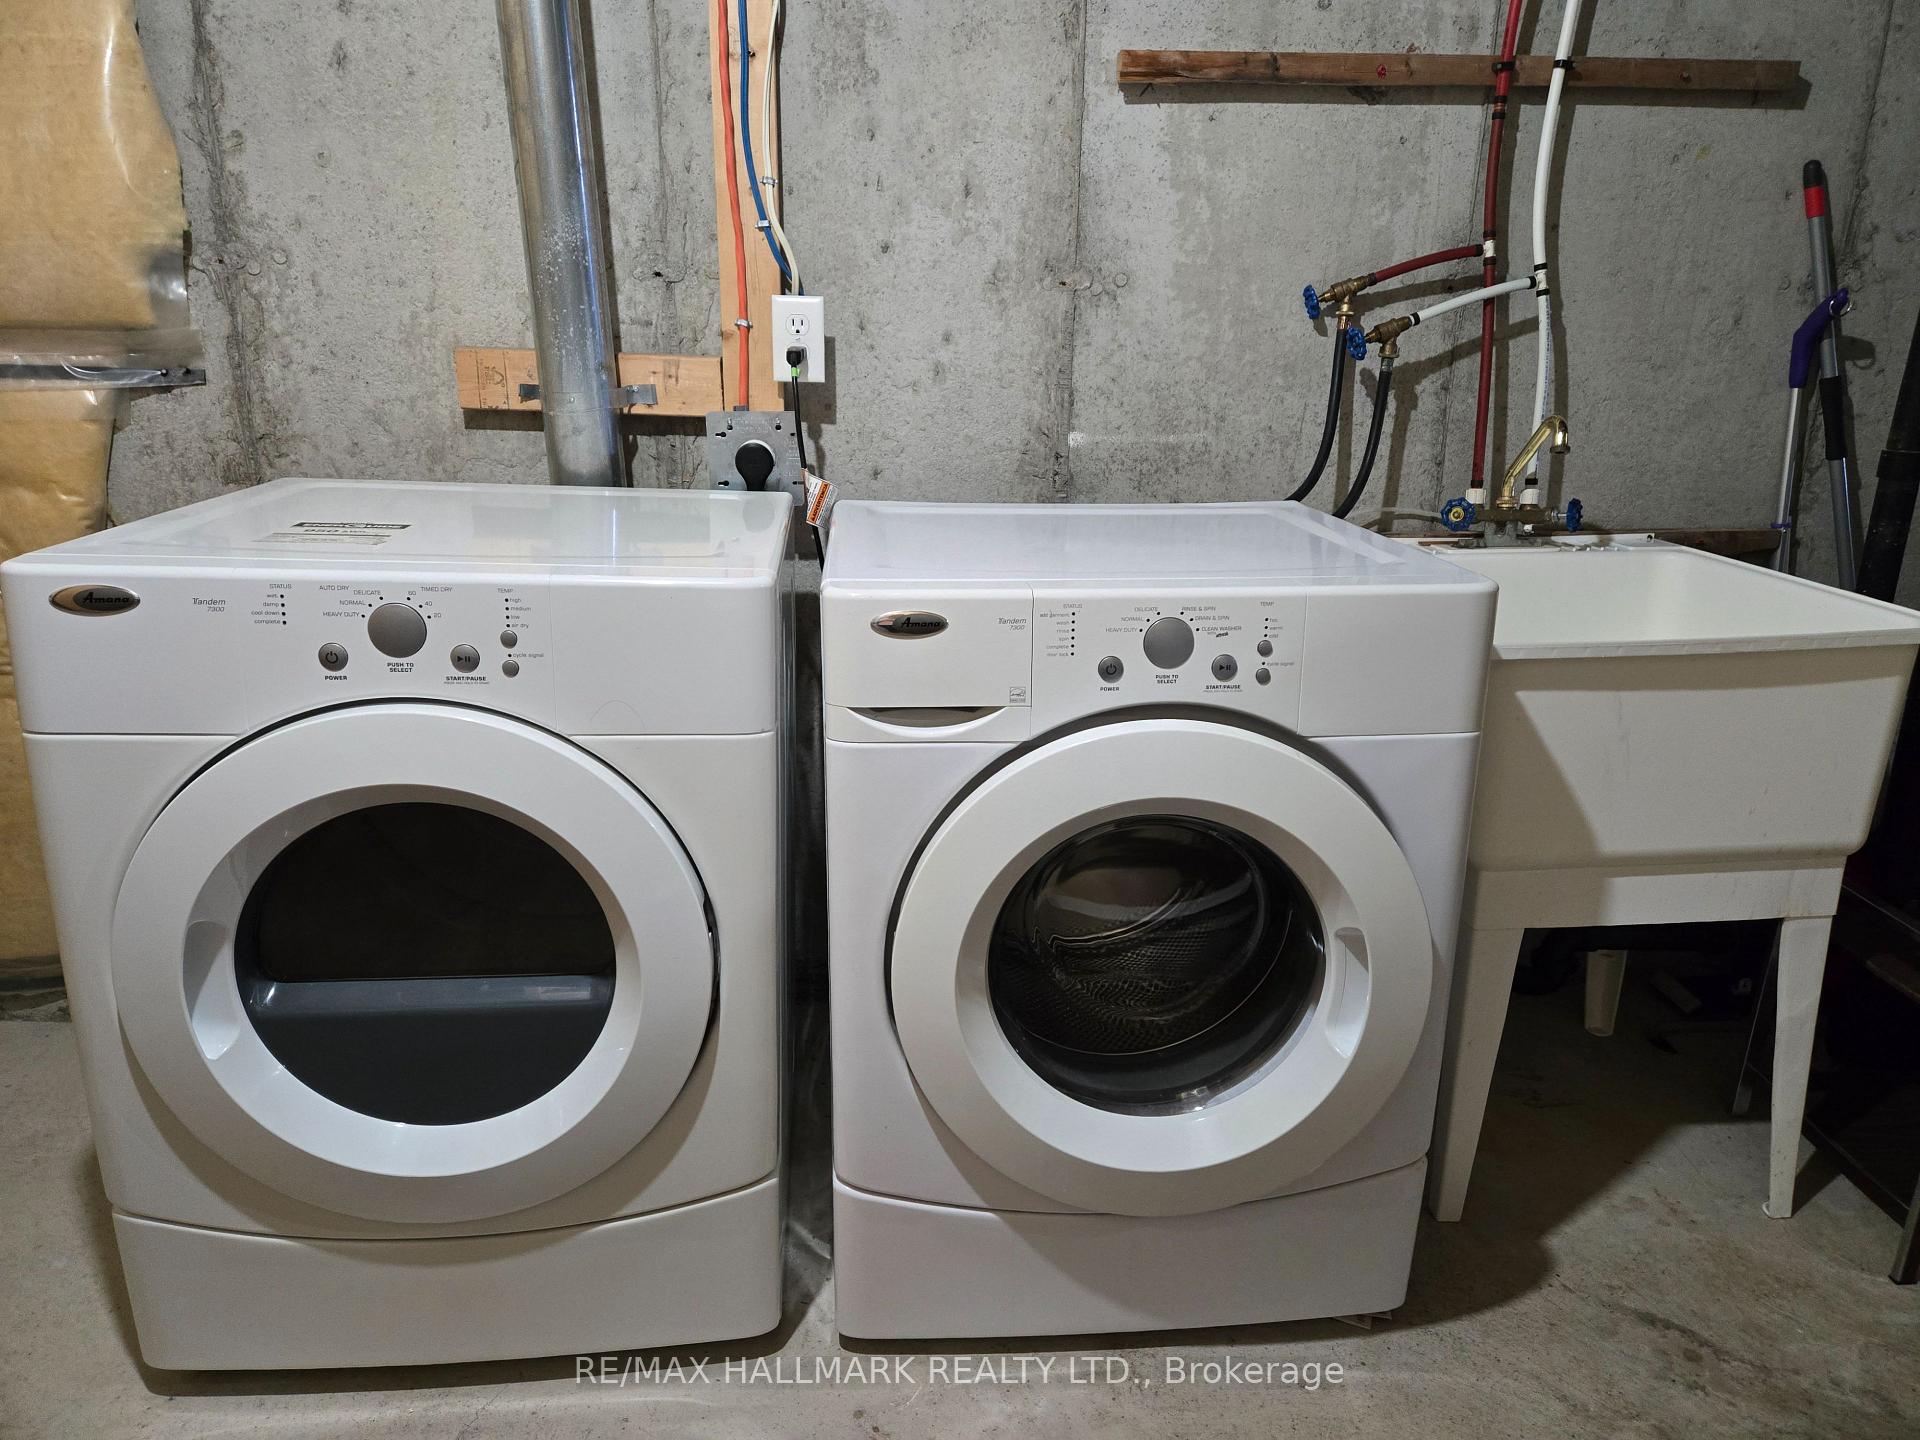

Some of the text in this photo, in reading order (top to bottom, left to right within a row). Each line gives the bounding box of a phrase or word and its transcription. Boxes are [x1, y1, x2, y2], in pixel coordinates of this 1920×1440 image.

[83, 592, 130, 604] Amana
[192, 597, 226, 606] Tandem
[901, 617, 941, 628] Amana
[998, 617, 1027, 625] Tandem
